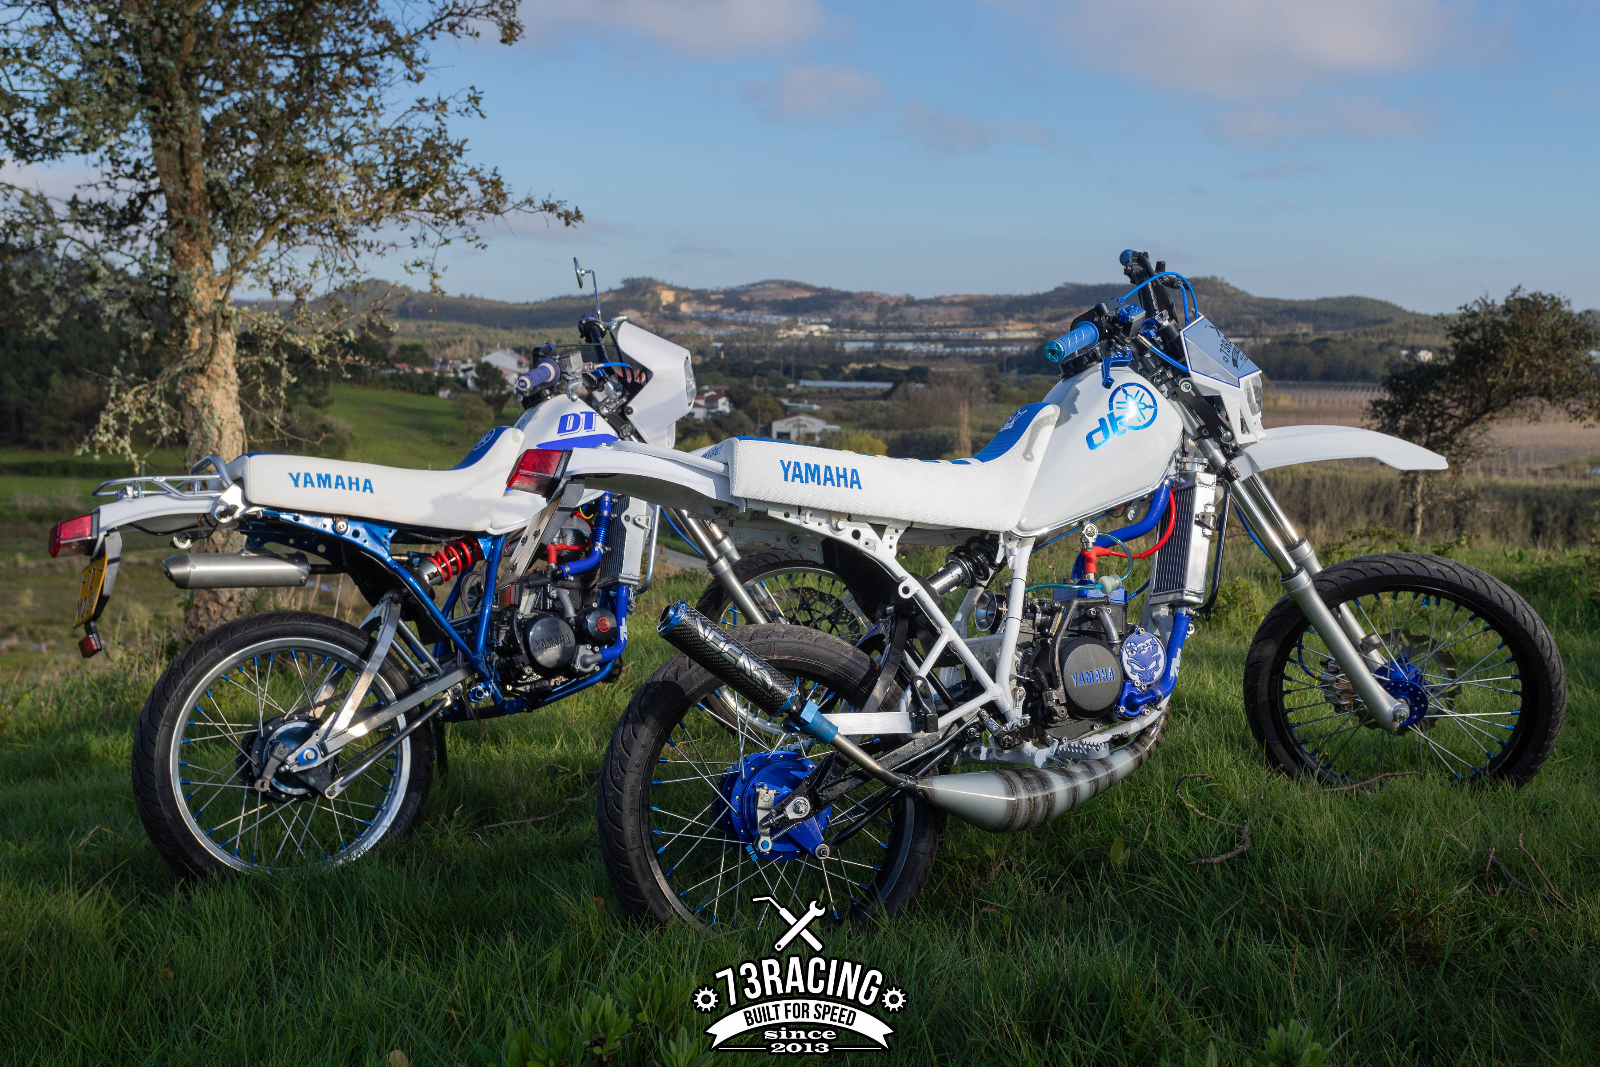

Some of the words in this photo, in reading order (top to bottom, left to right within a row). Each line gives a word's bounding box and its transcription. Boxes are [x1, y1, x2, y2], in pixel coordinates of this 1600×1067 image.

[557, 411, 600, 437] DT
[1085, 410, 1127, 450] dt
[288, 472, 374, 494] YAMAHA
[779, 459, 862, 490] YAMAHA
[1071, 667, 1115, 687] YAMAHA
